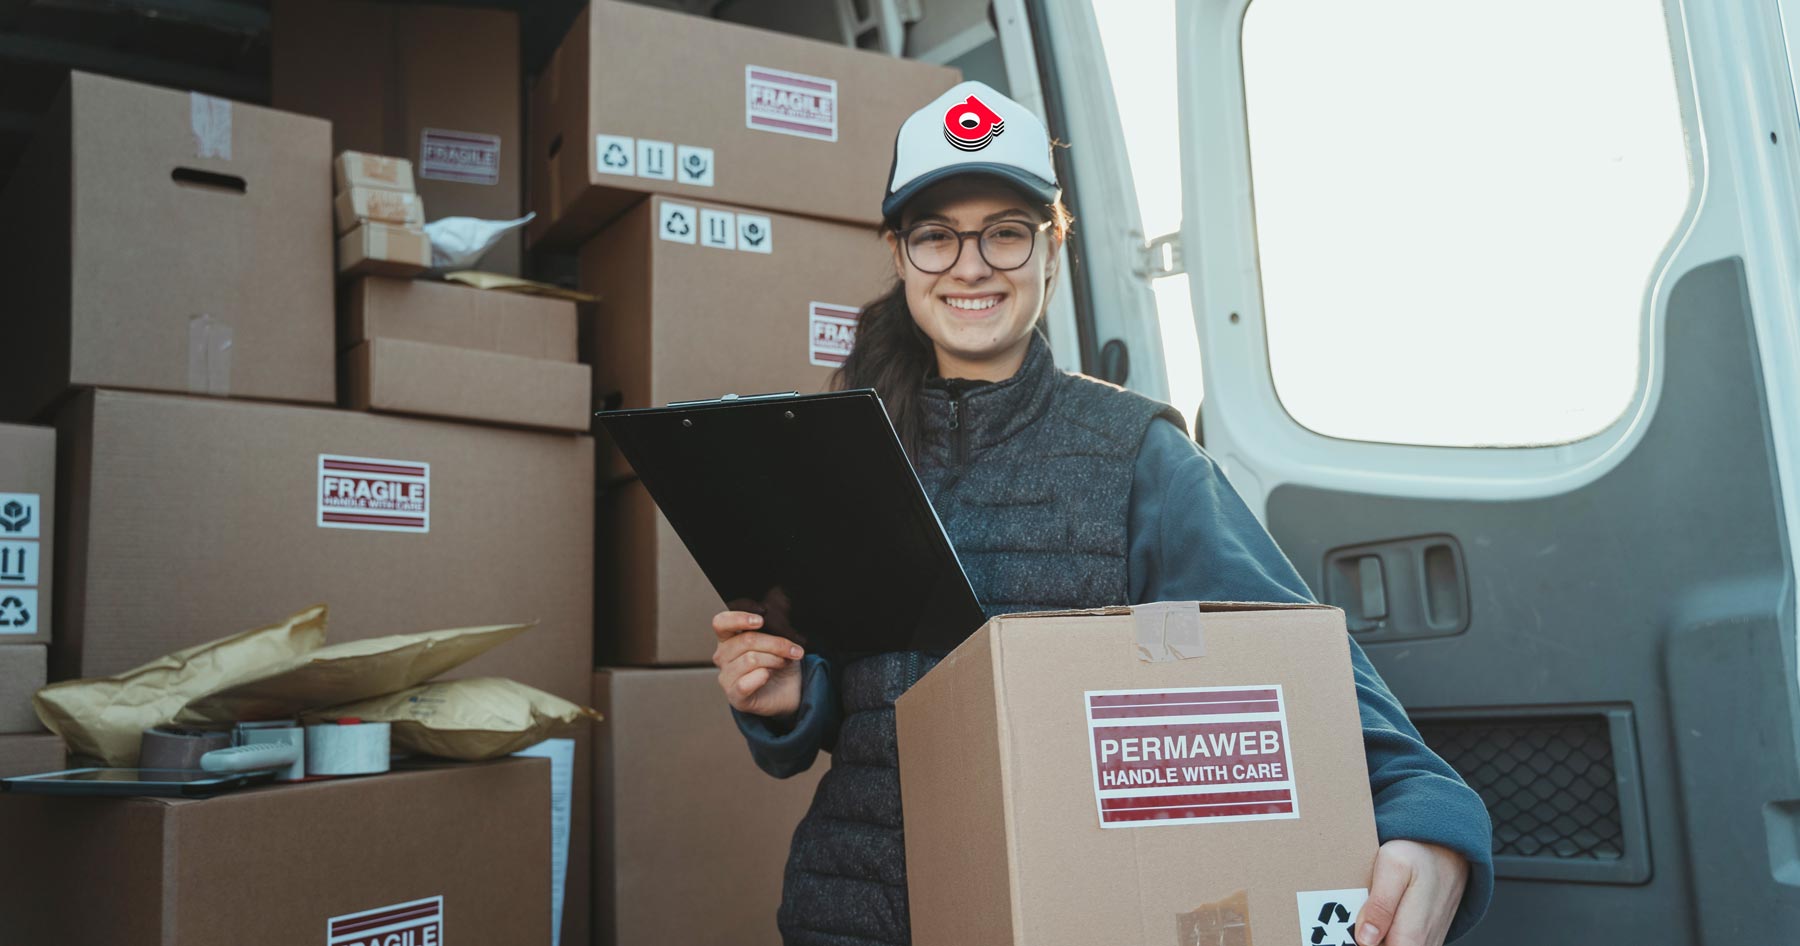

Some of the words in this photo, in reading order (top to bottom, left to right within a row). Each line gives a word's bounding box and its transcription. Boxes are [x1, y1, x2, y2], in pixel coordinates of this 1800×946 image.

[751, 86, 831, 115] FRAGILE
[324, 477, 424, 503] FRAGILE
[1100, 730, 1280, 763] PERMAWEB
[1102, 768, 1178, 786] HANDLE
[1182, 766, 1228, 782] WITH
[1232, 763, 1283, 780] CARE
